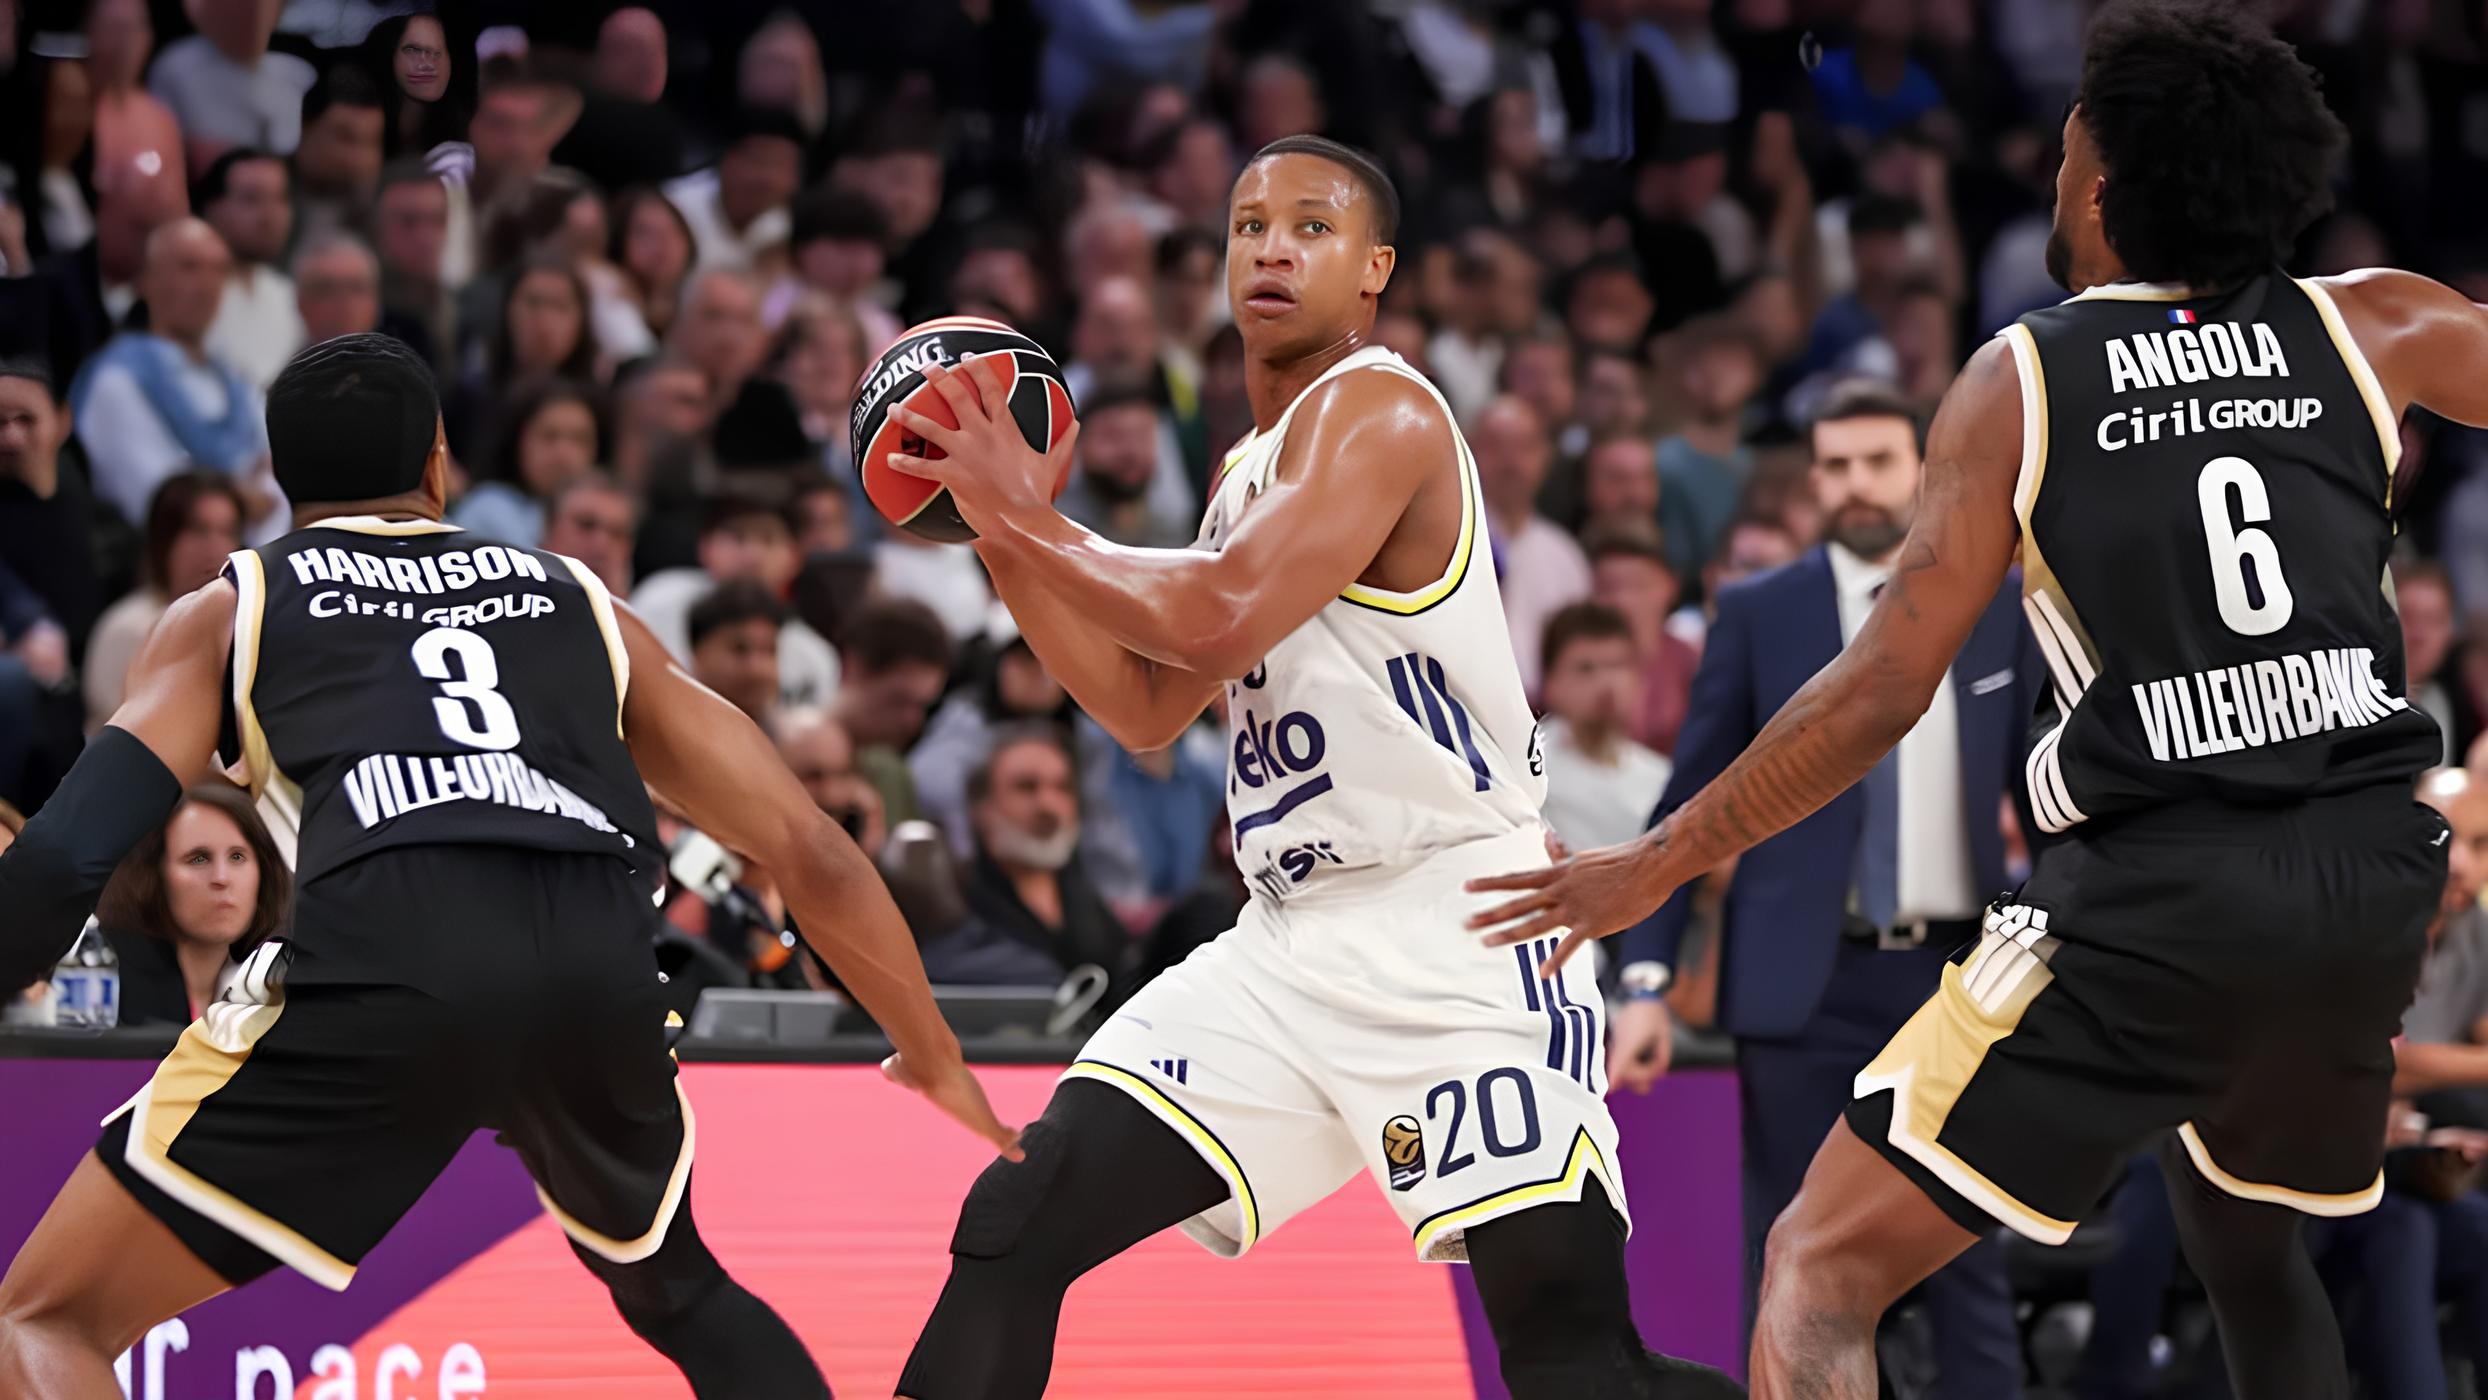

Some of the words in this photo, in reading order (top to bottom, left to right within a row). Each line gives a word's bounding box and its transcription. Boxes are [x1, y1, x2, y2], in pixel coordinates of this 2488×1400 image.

[2105, 321, 2290, 393] ANGOLA
[2097, 400, 2206, 452] Ciril
[2208, 398, 2322, 429] GROUP
[288, 546, 547, 594] HARRISON
[2198, 456, 2293, 636] 6
[421, 593, 556, 627] GROUP
[411, 627, 521, 751] 3
[1231, 709, 1325, 796] eko
[1426, 1067, 1541, 1178] 20
